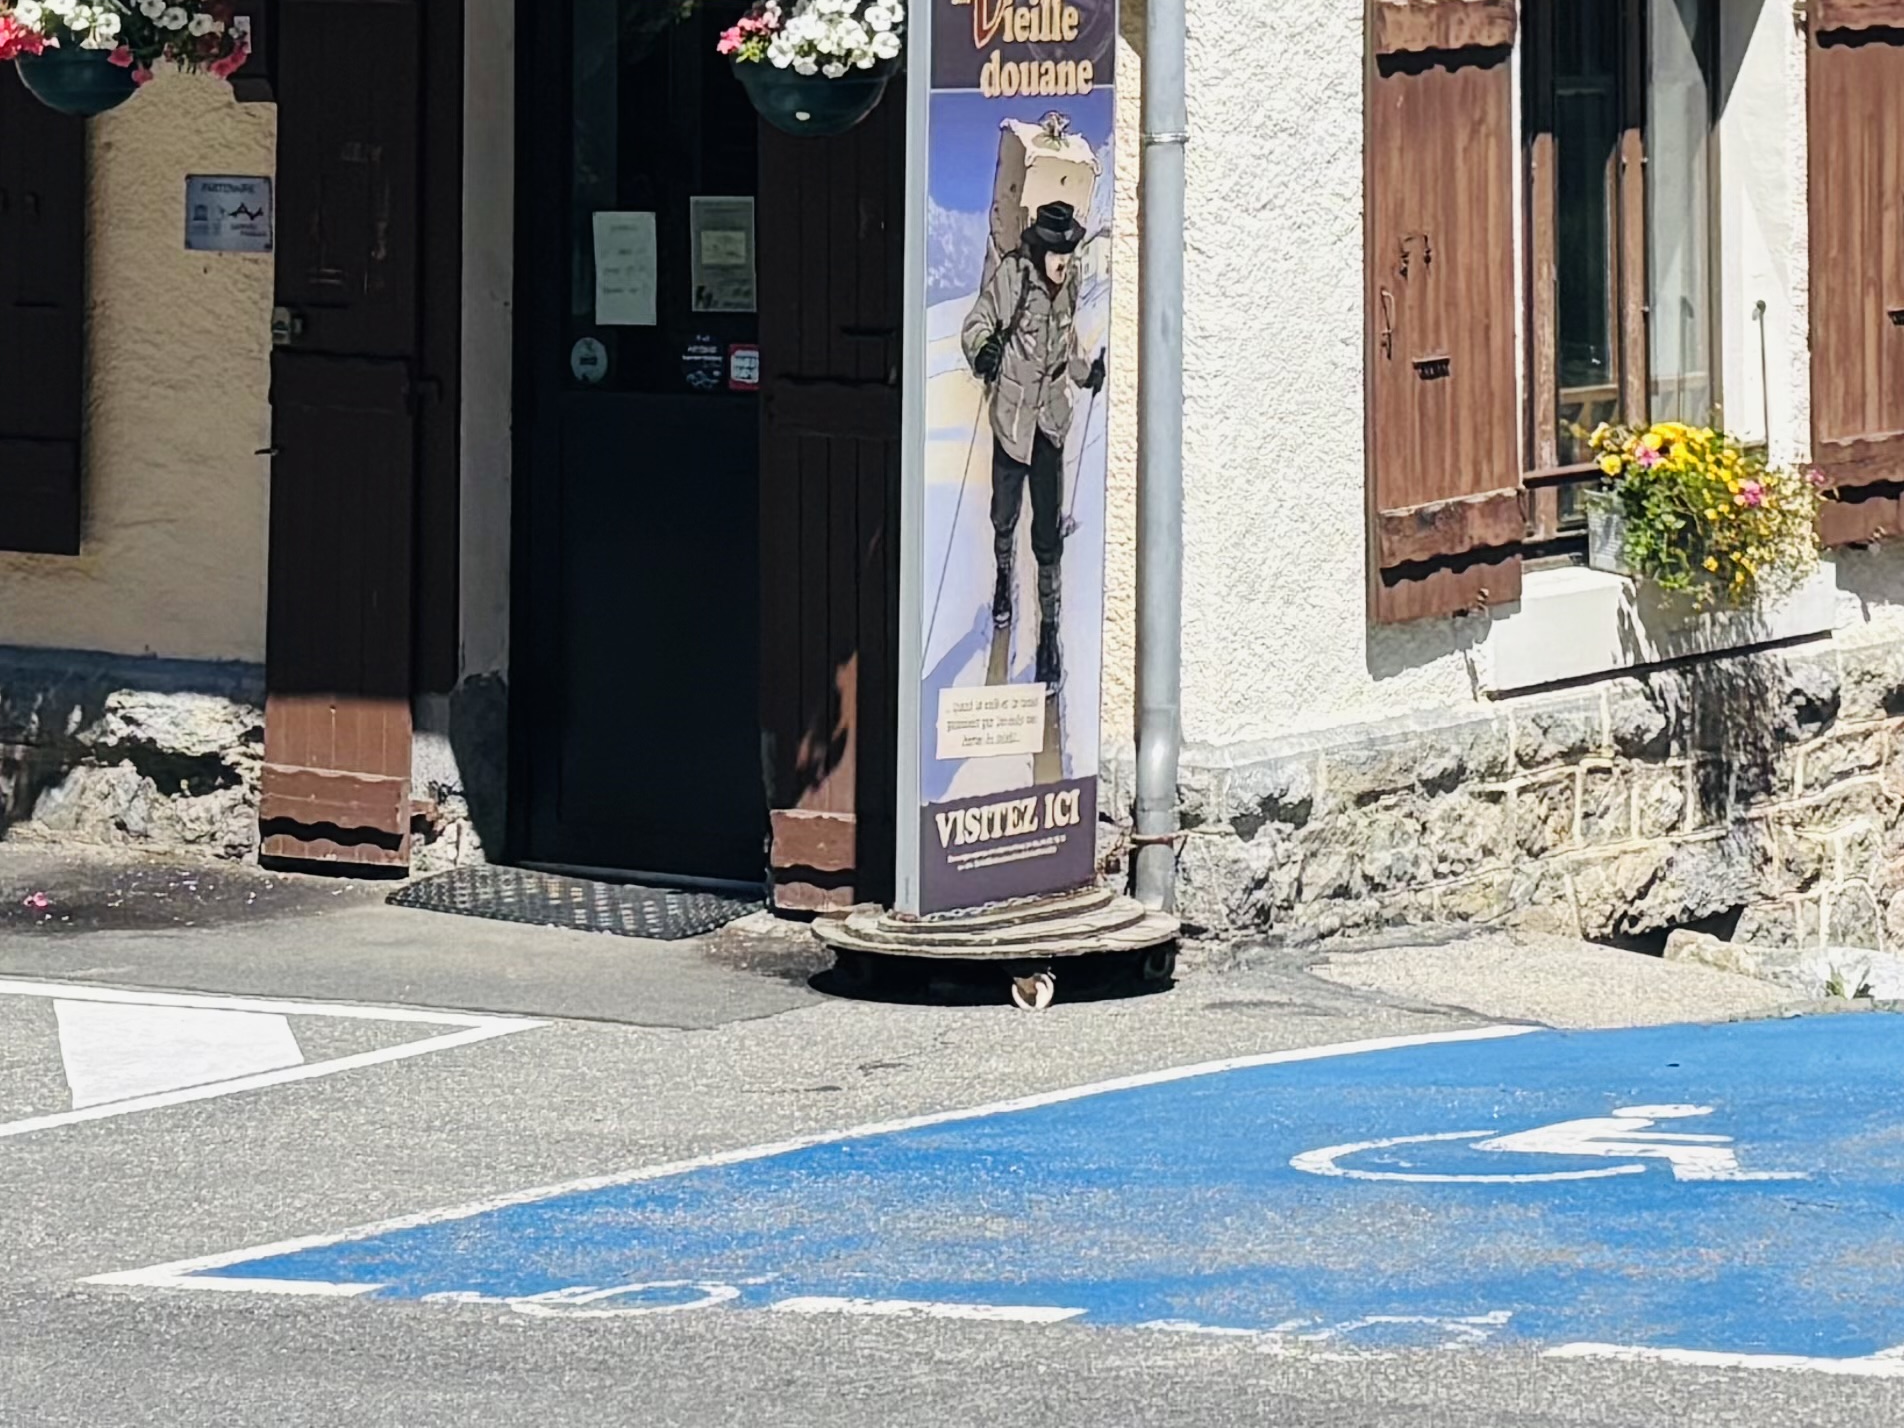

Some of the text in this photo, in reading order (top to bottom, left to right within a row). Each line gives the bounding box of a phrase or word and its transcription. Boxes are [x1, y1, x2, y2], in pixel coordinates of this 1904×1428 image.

[980, 48, 1094, 99] douane
[935, 788, 1081, 848] VISITEZ ICI
